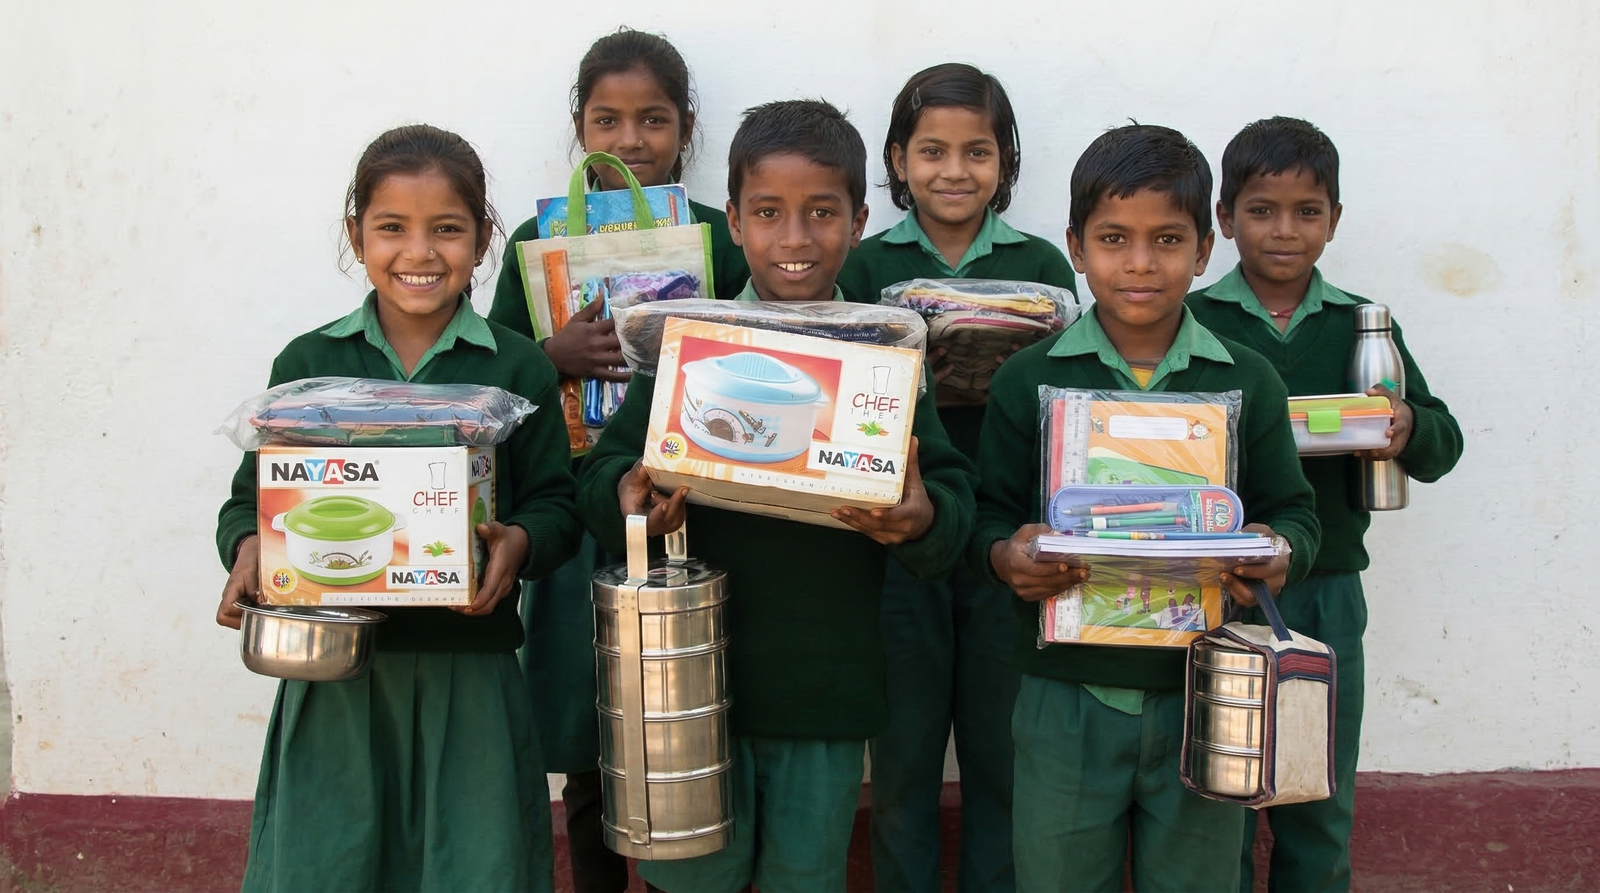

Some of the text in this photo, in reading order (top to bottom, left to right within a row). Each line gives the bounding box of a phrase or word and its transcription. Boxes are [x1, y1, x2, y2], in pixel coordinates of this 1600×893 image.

[852, 393, 900, 413] CHEF
[271, 459, 380, 484] NAYASA
[818, 450, 896, 475] NAYASA
[413, 491, 459, 507] CHEF
[391, 570, 460, 585] NAYASA
